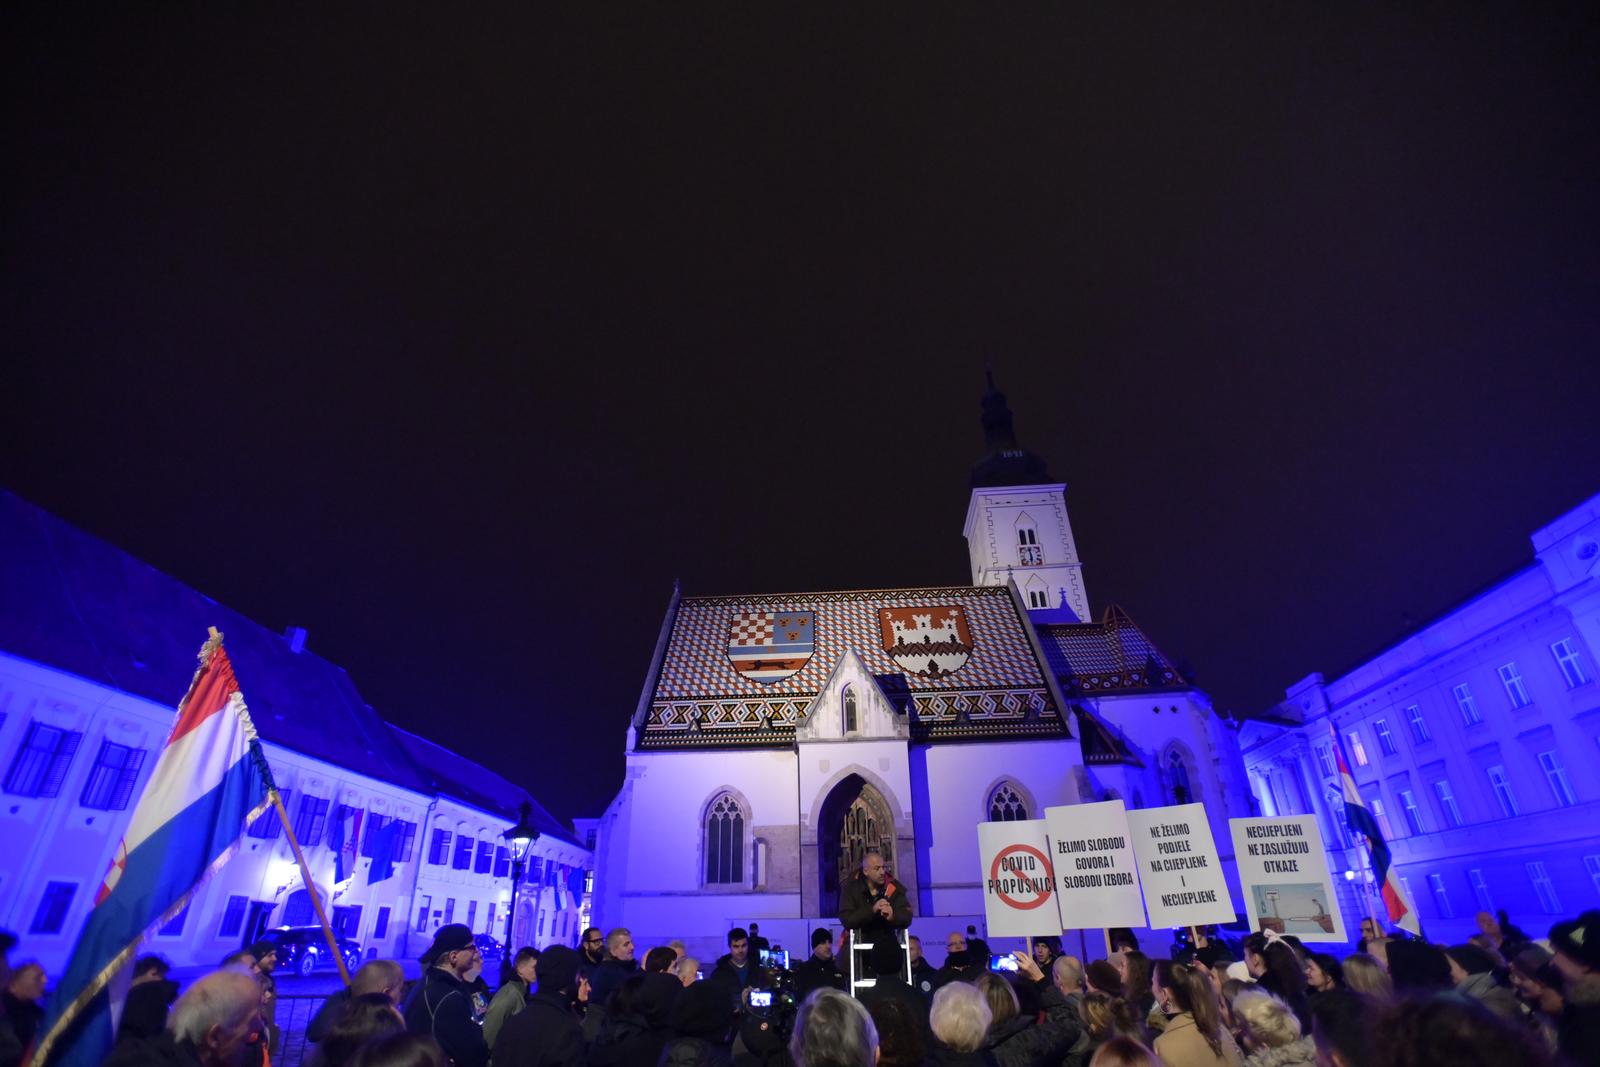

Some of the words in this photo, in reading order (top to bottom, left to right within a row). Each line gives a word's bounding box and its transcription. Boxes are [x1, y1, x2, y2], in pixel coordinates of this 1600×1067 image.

[1150, 826, 1162, 838] NE
[1160, 823, 1190, 837] ŽELIMO
[1246, 824, 1303, 838] NECIJEPLJENI
[1058, 840, 1087, 854] ŽELIMO
[1087, 836, 1125, 852] SLOBODU
[1157, 840, 1192, 854] PODJELE
[1248, 843, 1260, 856] NE
[1260, 839, 1310, 855] ZASLUŽUJU
[1001, 856, 1036, 872] COVID
[1075, 856, 1110, 870] GOVORA
[1110, 855, 1115, 868] I
[1150, 860, 1164, 873] NA
[1163, 855, 1208, 872] CIJEPLJENE
[1263, 860, 1299, 873] OTKAZE
[1064, 874, 1102, 889] SLOBODU
[1103, 872, 1134, 887] IZBORA
[1180, 875, 1186, 887] I
[1161, 890, 1217, 907] NECIJEPLJENE
